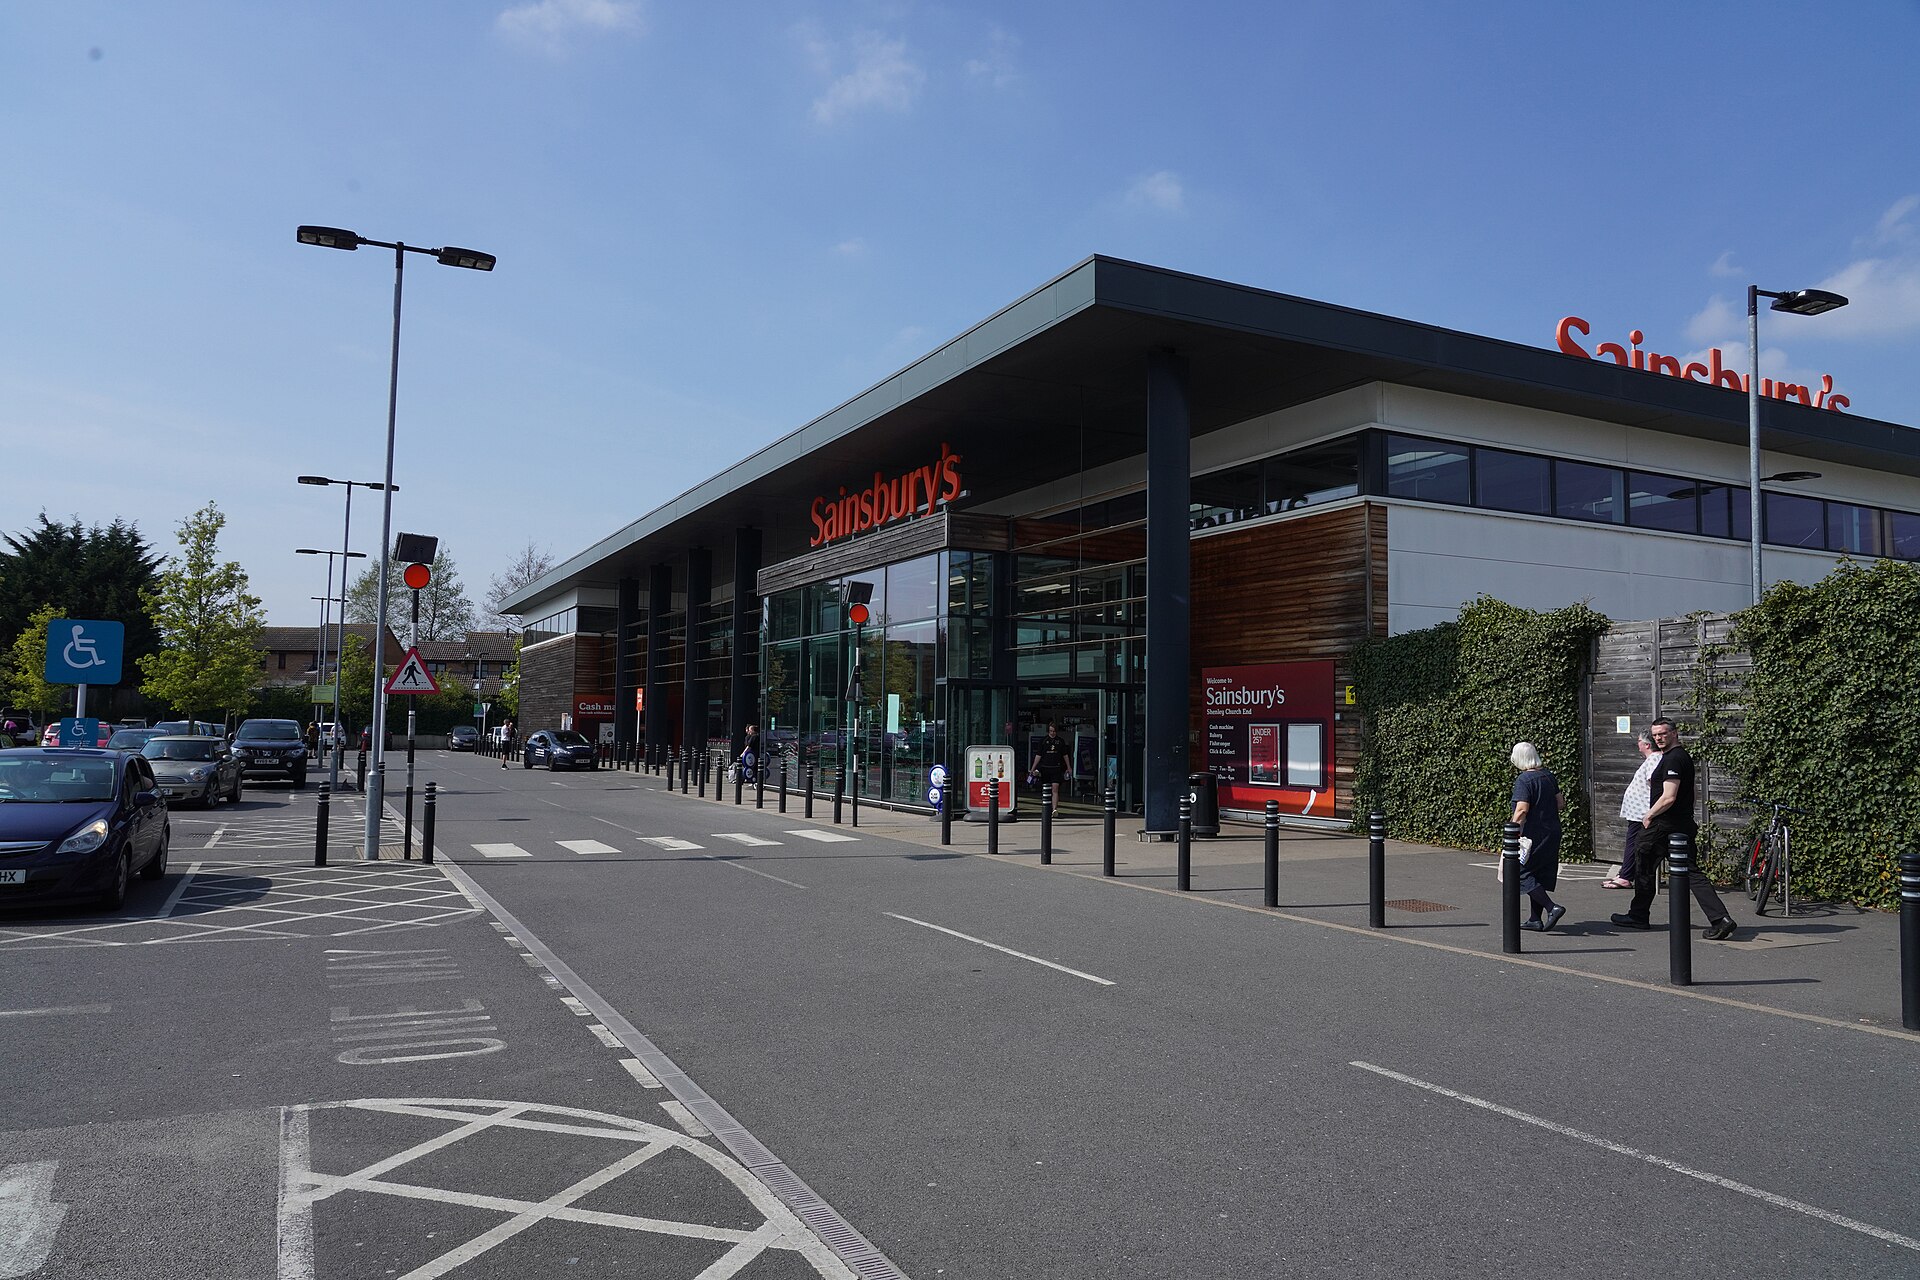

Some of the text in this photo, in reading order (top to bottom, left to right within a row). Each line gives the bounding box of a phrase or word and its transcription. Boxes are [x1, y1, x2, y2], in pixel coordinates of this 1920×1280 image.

[810, 442, 961, 547] Sainsbury's
[1206, 685, 1285, 709] Sainsbury's
[578, 702, 601, 711] Cash
[1206, 708, 1224, 716] Shenley
[1252, 728, 1271, 736] UNDER
[1252, 736, 1262, 744] 25?
